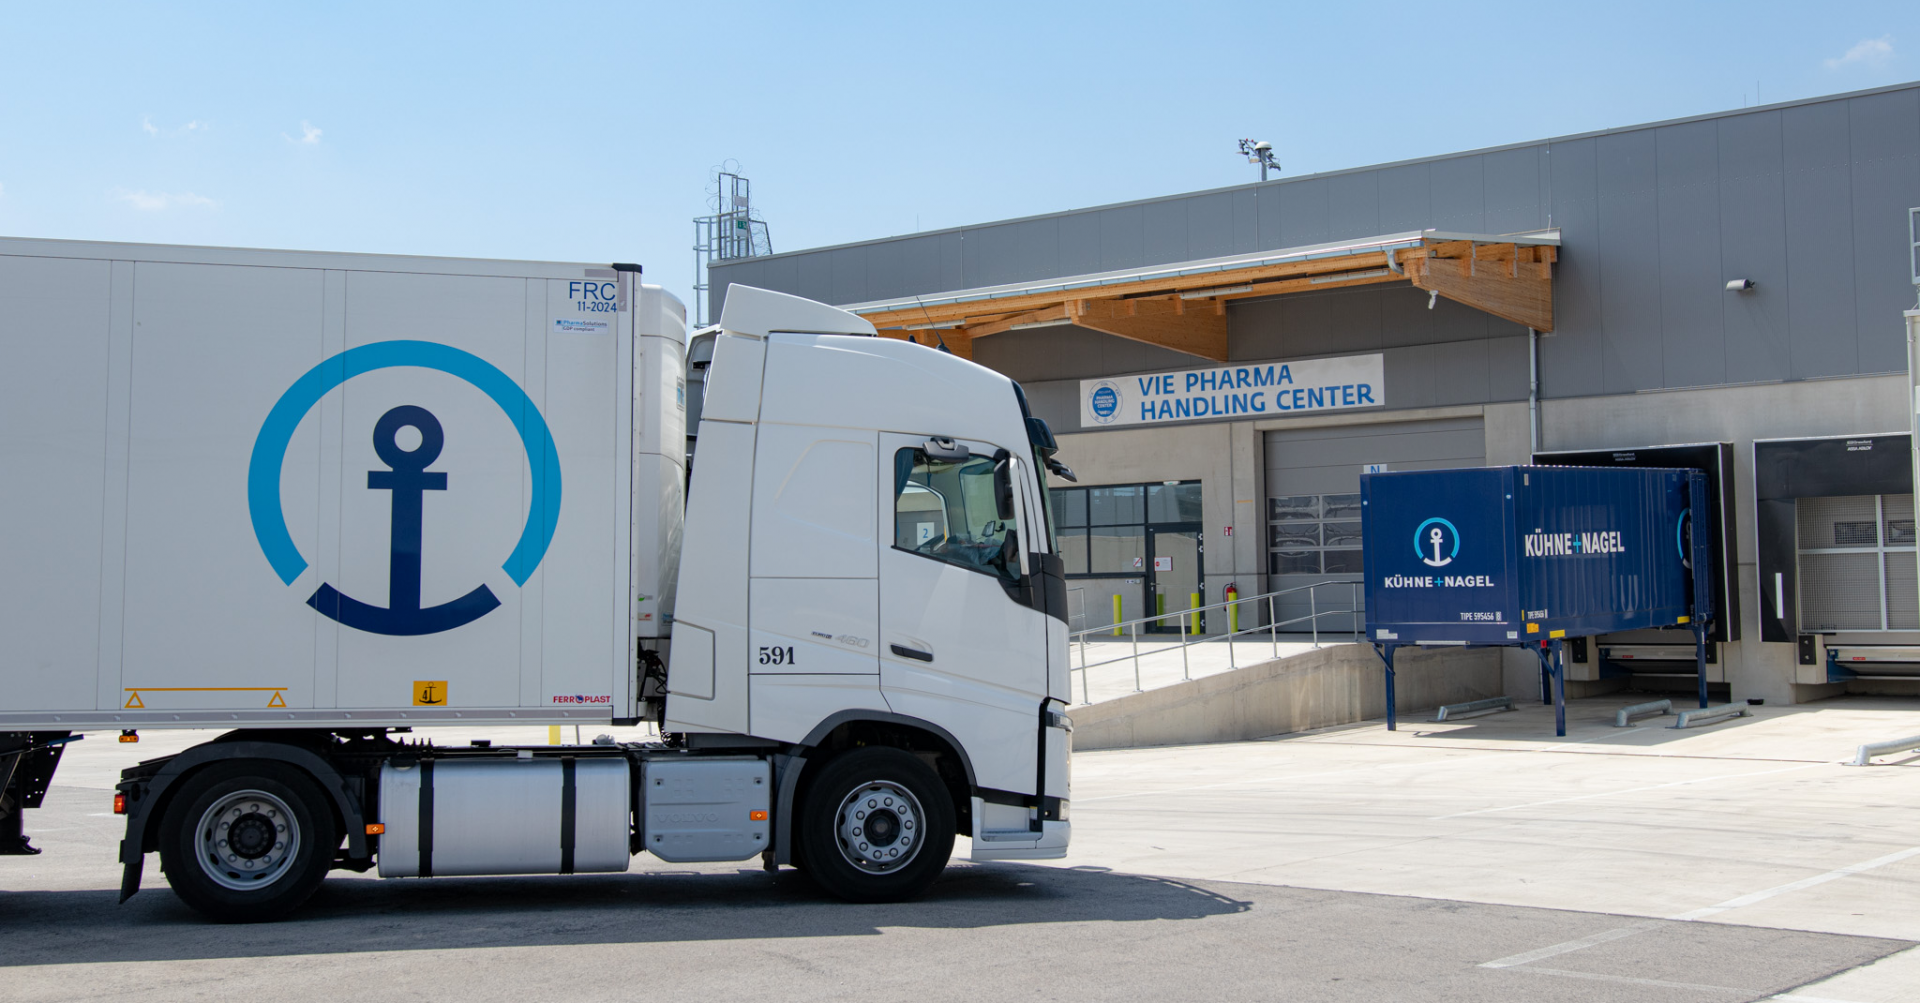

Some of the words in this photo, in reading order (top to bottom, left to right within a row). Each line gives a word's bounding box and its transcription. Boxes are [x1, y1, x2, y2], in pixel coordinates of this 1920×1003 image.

[569, 281, 616, 301] FRC
[577, 301, 617, 313] 11-2024
[1138, 374, 1175, 396] VIE
[1185, 364, 1294, 393] PHARMA
[1140, 391, 1265, 421] HANDLING
[1276, 383, 1375, 411] CENTER
[922, 528, 929, 539] 2
[1525, 528, 1625, 557] KÜHNE+NAGEL
[1384, 574, 1494, 588] KÜHNE+NAGEL
[1460, 612, 1473, 621] TIPE
[1474, 612, 1494, 621] 595456
[759, 646, 796, 665] 591
[422, 690, 428, 700] 4
[654, 813, 719, 824] VOLVO
